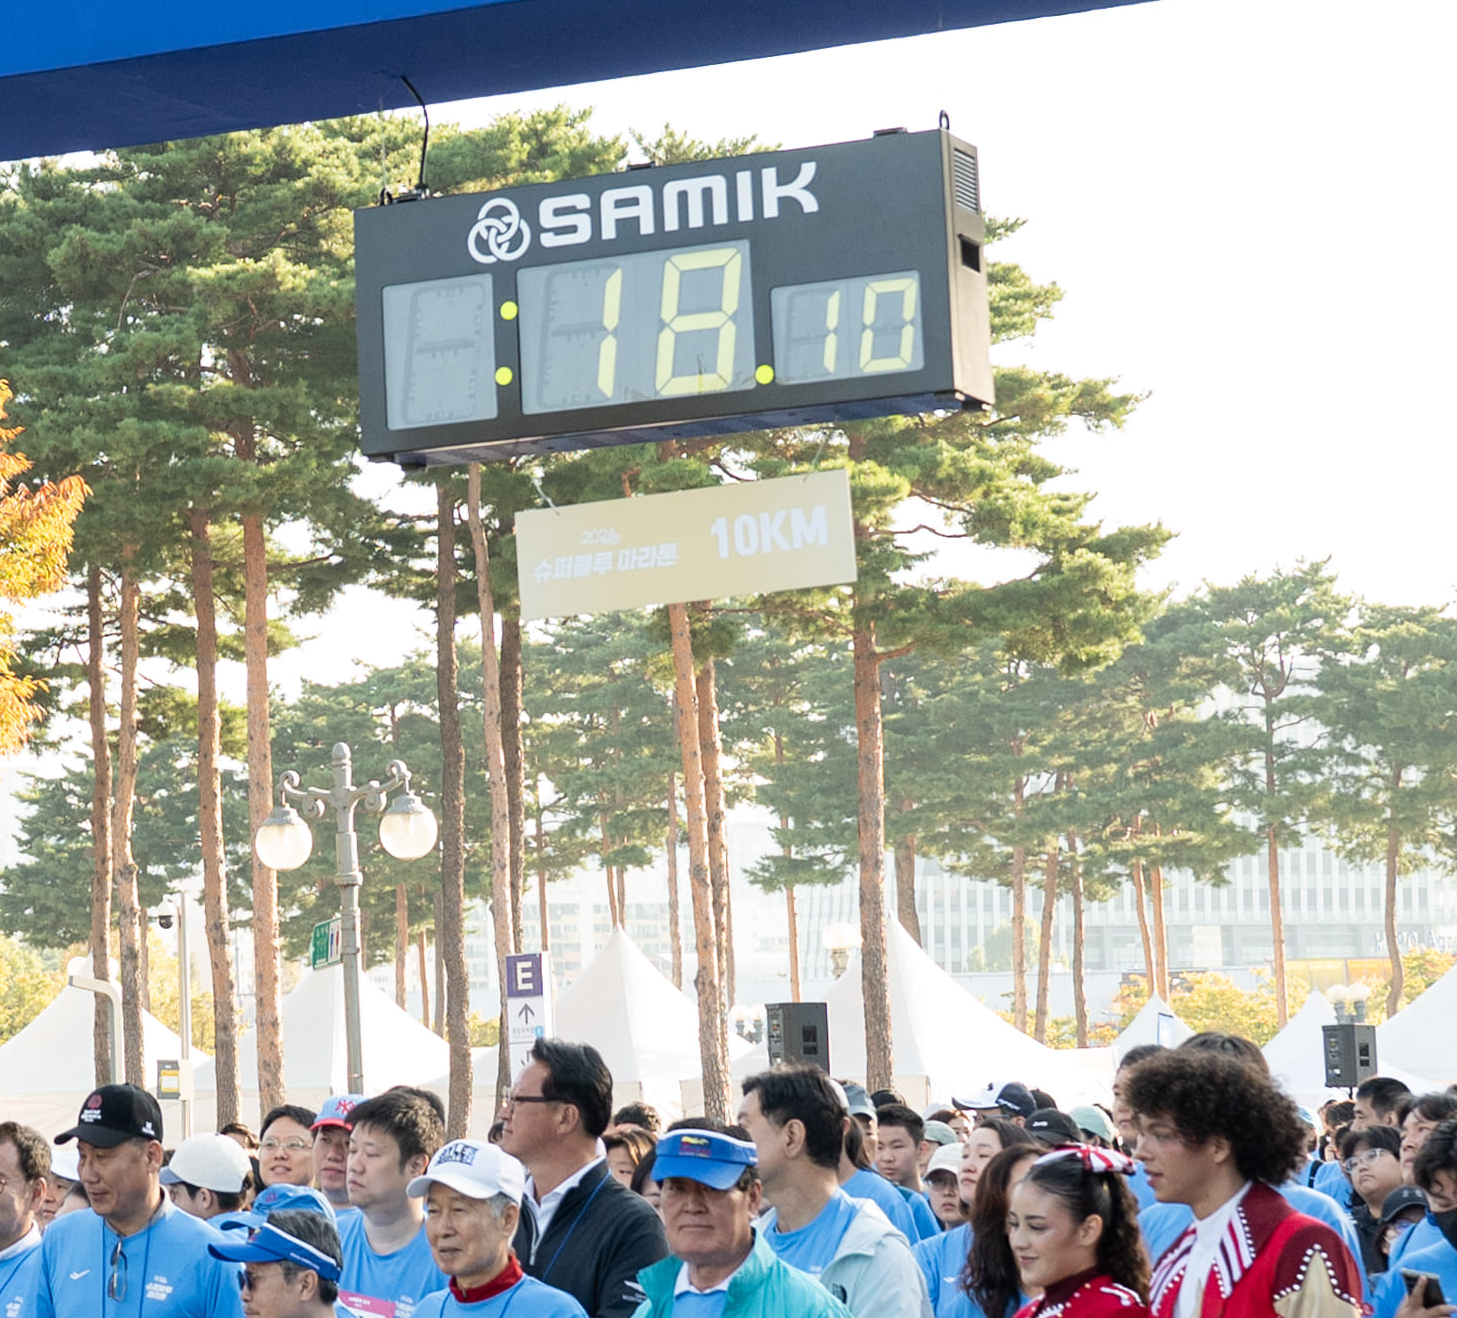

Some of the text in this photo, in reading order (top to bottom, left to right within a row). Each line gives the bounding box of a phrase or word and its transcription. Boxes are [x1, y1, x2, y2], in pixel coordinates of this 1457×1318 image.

[538, 161, 818, 249] SAMIK
[710, 505, 828, 559] 10KM
[533, 542, 679, 583] 슈퍼블루 마라톤
[517, 962, 533, 990] E
